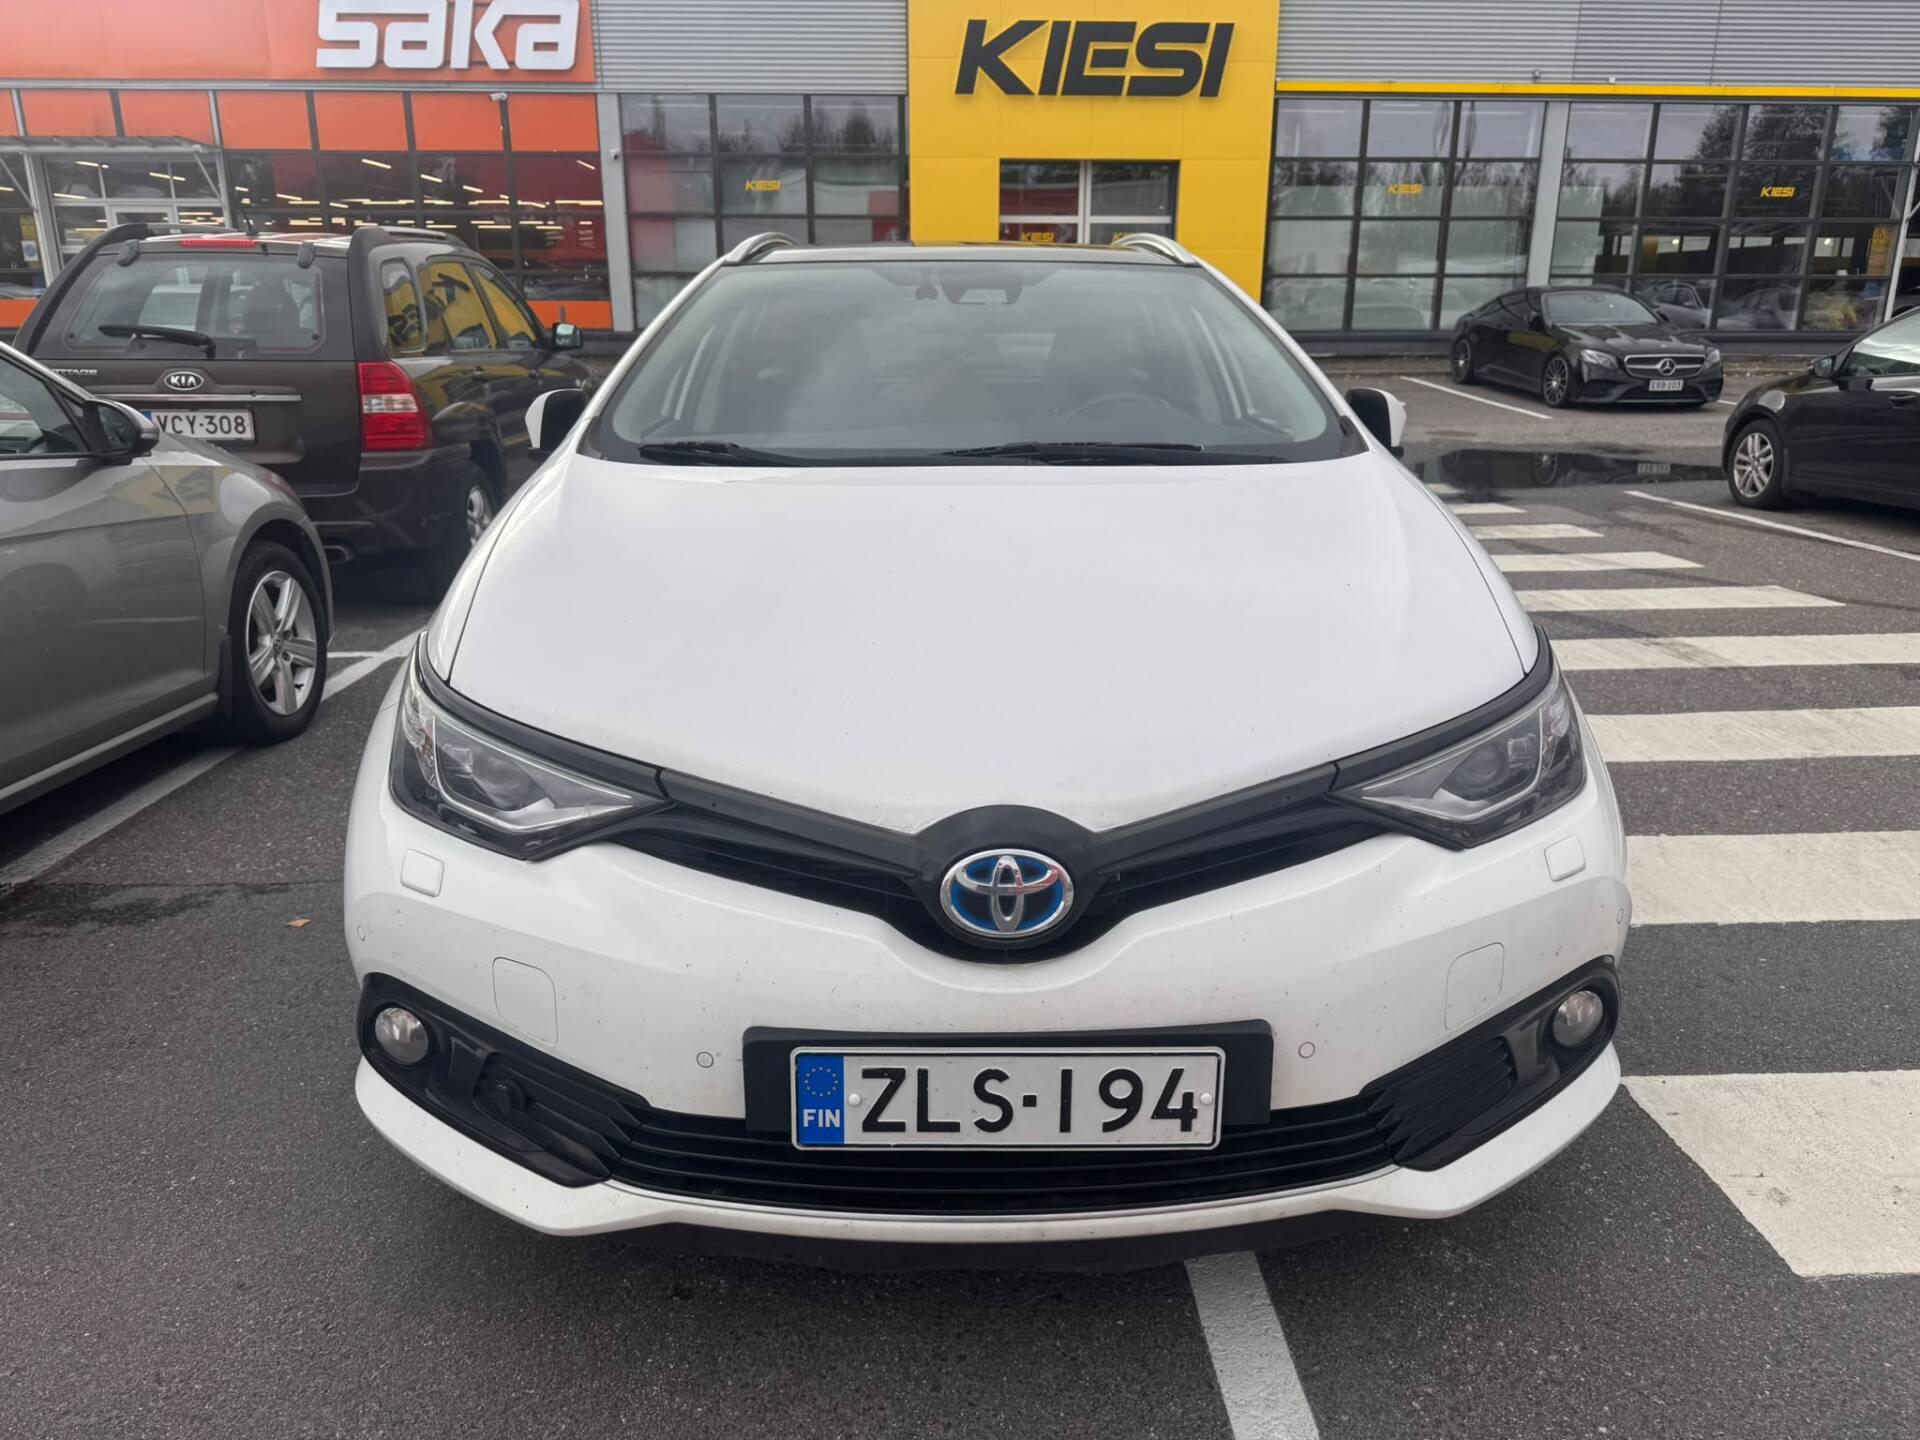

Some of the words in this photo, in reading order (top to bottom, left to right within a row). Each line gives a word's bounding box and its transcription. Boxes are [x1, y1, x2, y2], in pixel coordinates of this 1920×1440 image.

[954, 19, 1236, 98] KIESI
[744, 179, 781, 192] KIESI
[1387, 183, 1424, 196] KIESI
[1760, 186, 1796, 198] KIESI
[1019, 231, 1056, 243] KIESI
[169, 374, 198, 387] KIA
[156, 414, 247, 435] VCY-308
[861, 1067, 1199, 1134] ZLS-194
[802, 1108, 841, 1129] FIN
